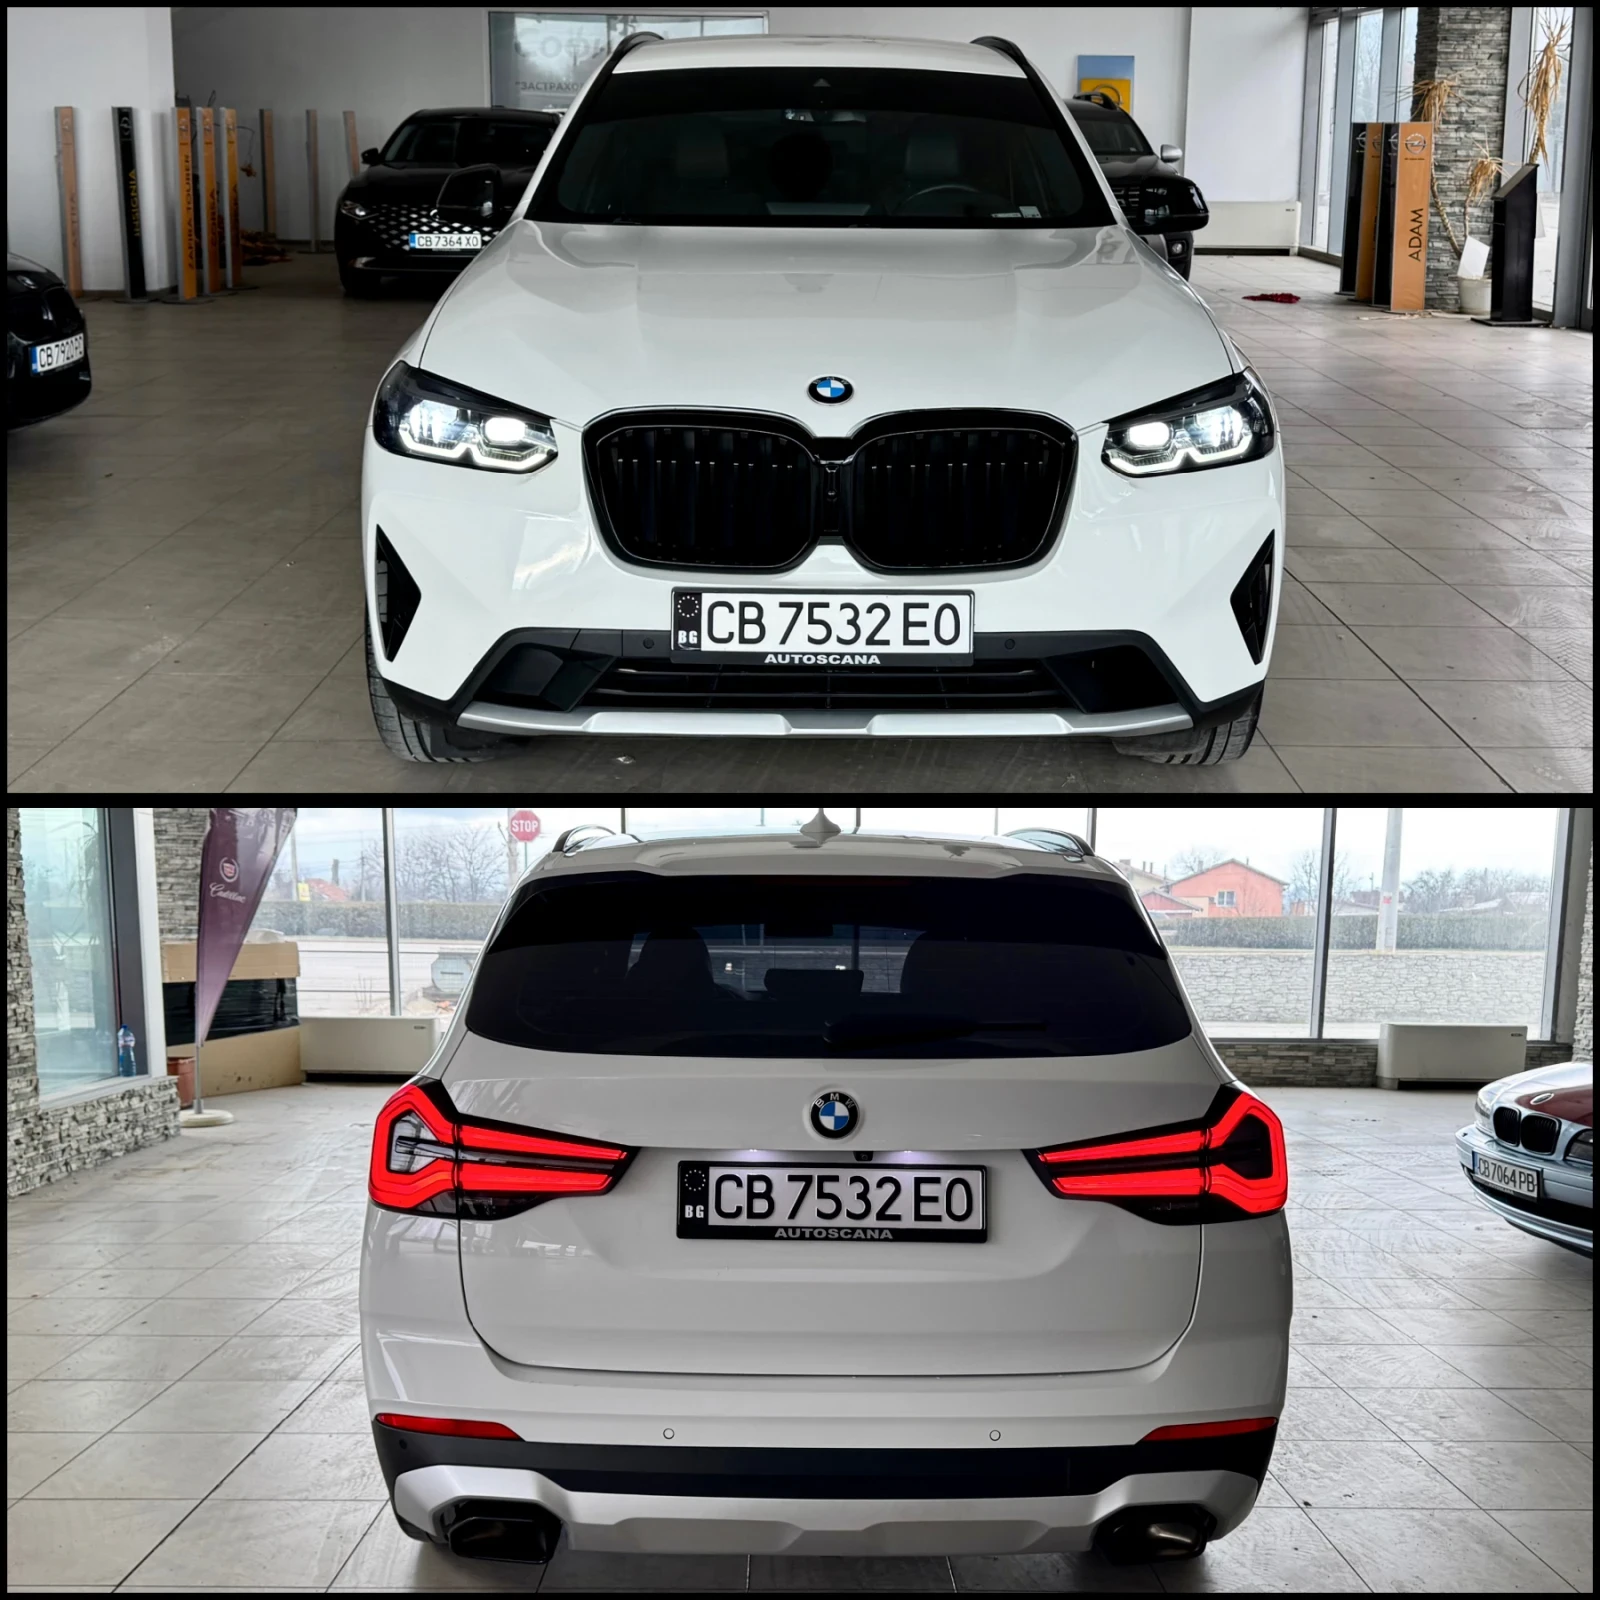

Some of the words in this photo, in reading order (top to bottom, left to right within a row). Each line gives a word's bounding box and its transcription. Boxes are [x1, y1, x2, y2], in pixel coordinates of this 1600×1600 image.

[1407, 208, 1424, 262] ADAM
[778, 601, 891, 646] 7532
[677, 630, 698, 644] BG
[764, 654, 881, 665] AUTOSCANA
[511, 820, 539, 832] STOP
[815, 1092, 855, 1108] BMW
[786, 1175, 902, 1221] 7532
[684, 1205, 704, 1219] BG
[774, 1228, 893, 1240] AUTOSCANA
